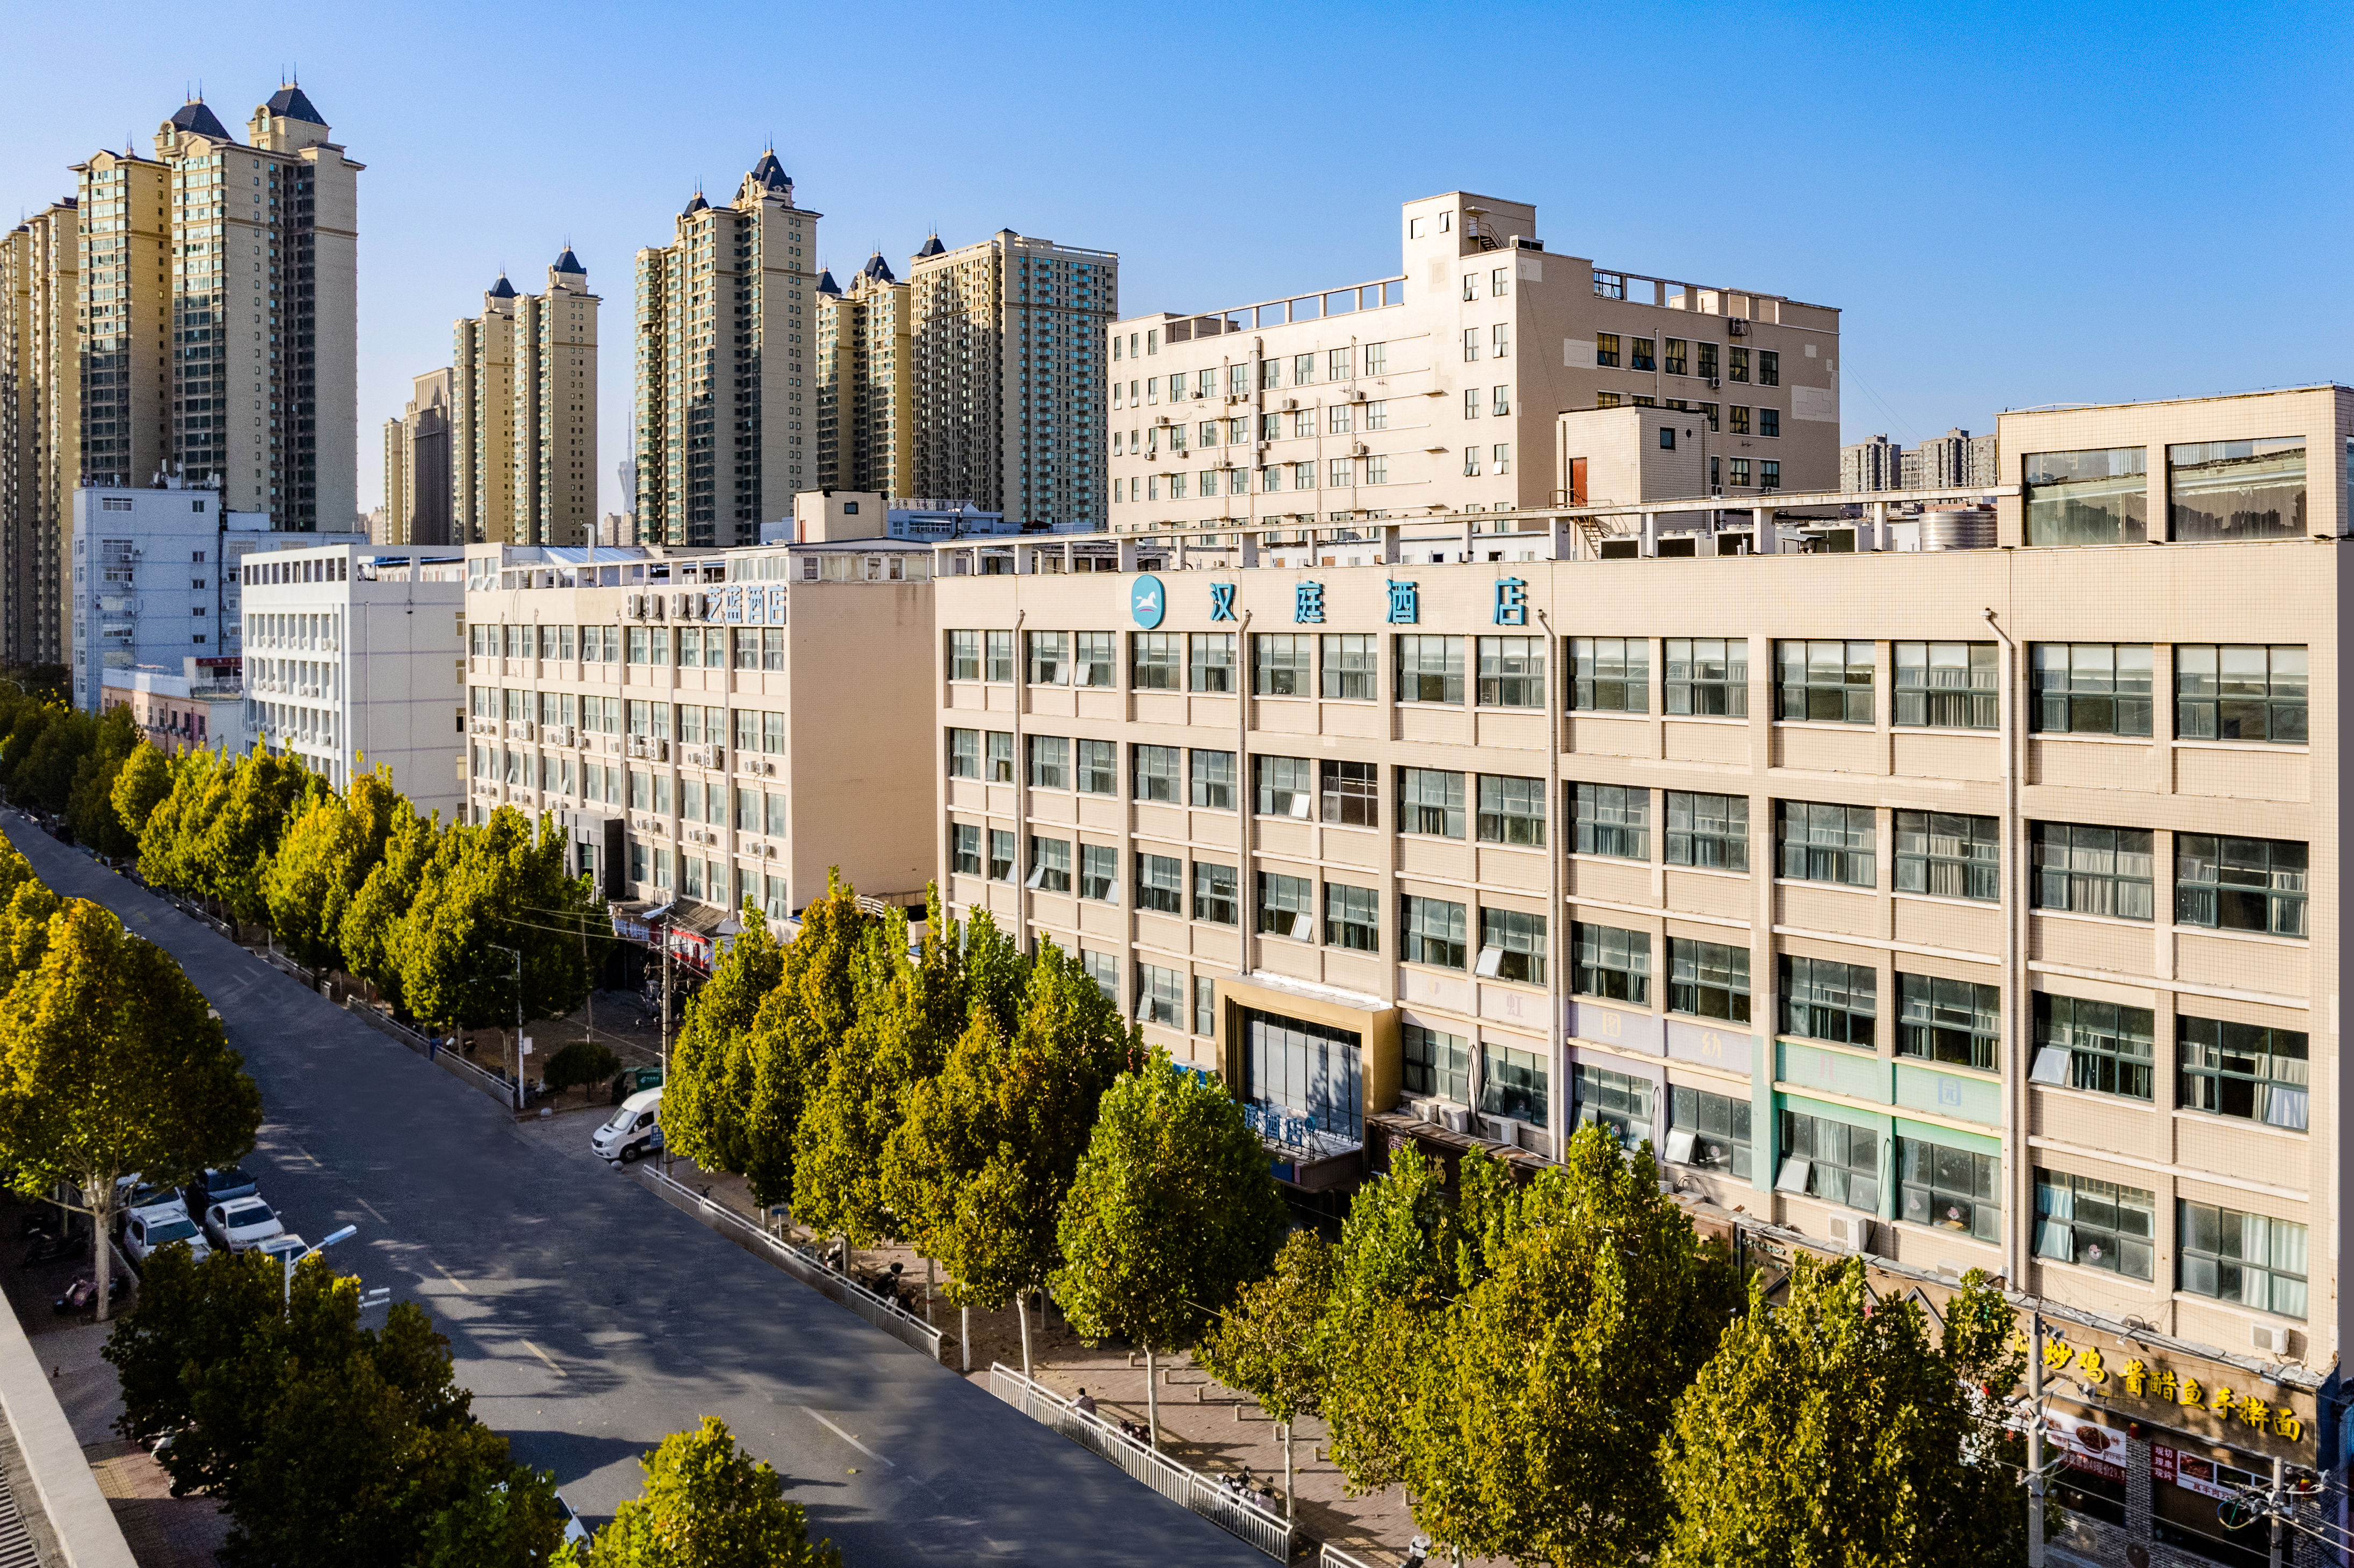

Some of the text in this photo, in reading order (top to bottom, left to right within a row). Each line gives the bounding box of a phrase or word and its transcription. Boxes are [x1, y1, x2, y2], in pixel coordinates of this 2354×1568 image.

[706, 584, 786, 624] 芝蓝酒店
[1209, 577, 1526, 625] 汉庭酒店
